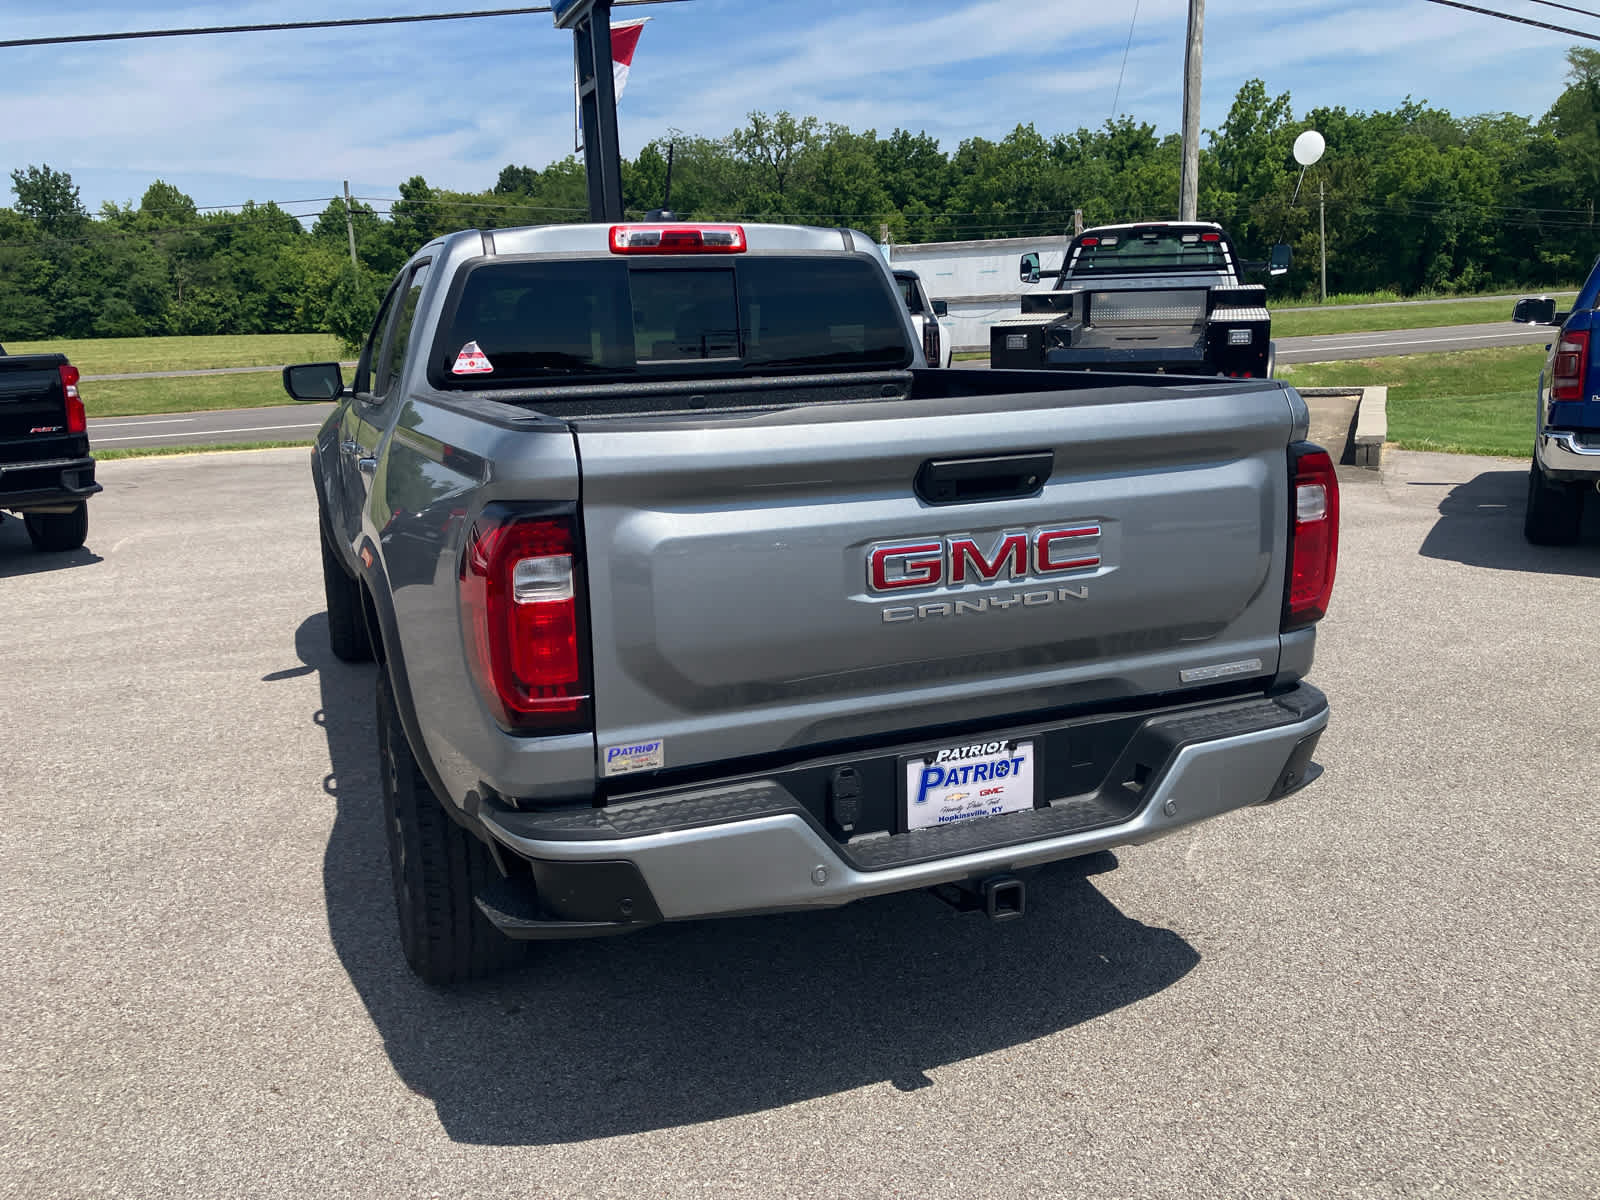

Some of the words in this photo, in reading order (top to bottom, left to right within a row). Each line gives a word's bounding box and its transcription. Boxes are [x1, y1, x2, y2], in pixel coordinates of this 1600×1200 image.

[866, 520, 1102, 593] GMC
[881, 586, 1089, 623] CANYON
[607, 742, 661, 763] PATRIOT
[935, 740, 1009, 763] PATRIOT
[915, 757, 1025, 803] PATRIOT
[979, 786, 1005, 797] GMC
[938, 809, 990, 823] Hopkinsville,
[991, 805, 1004, 814] KY
